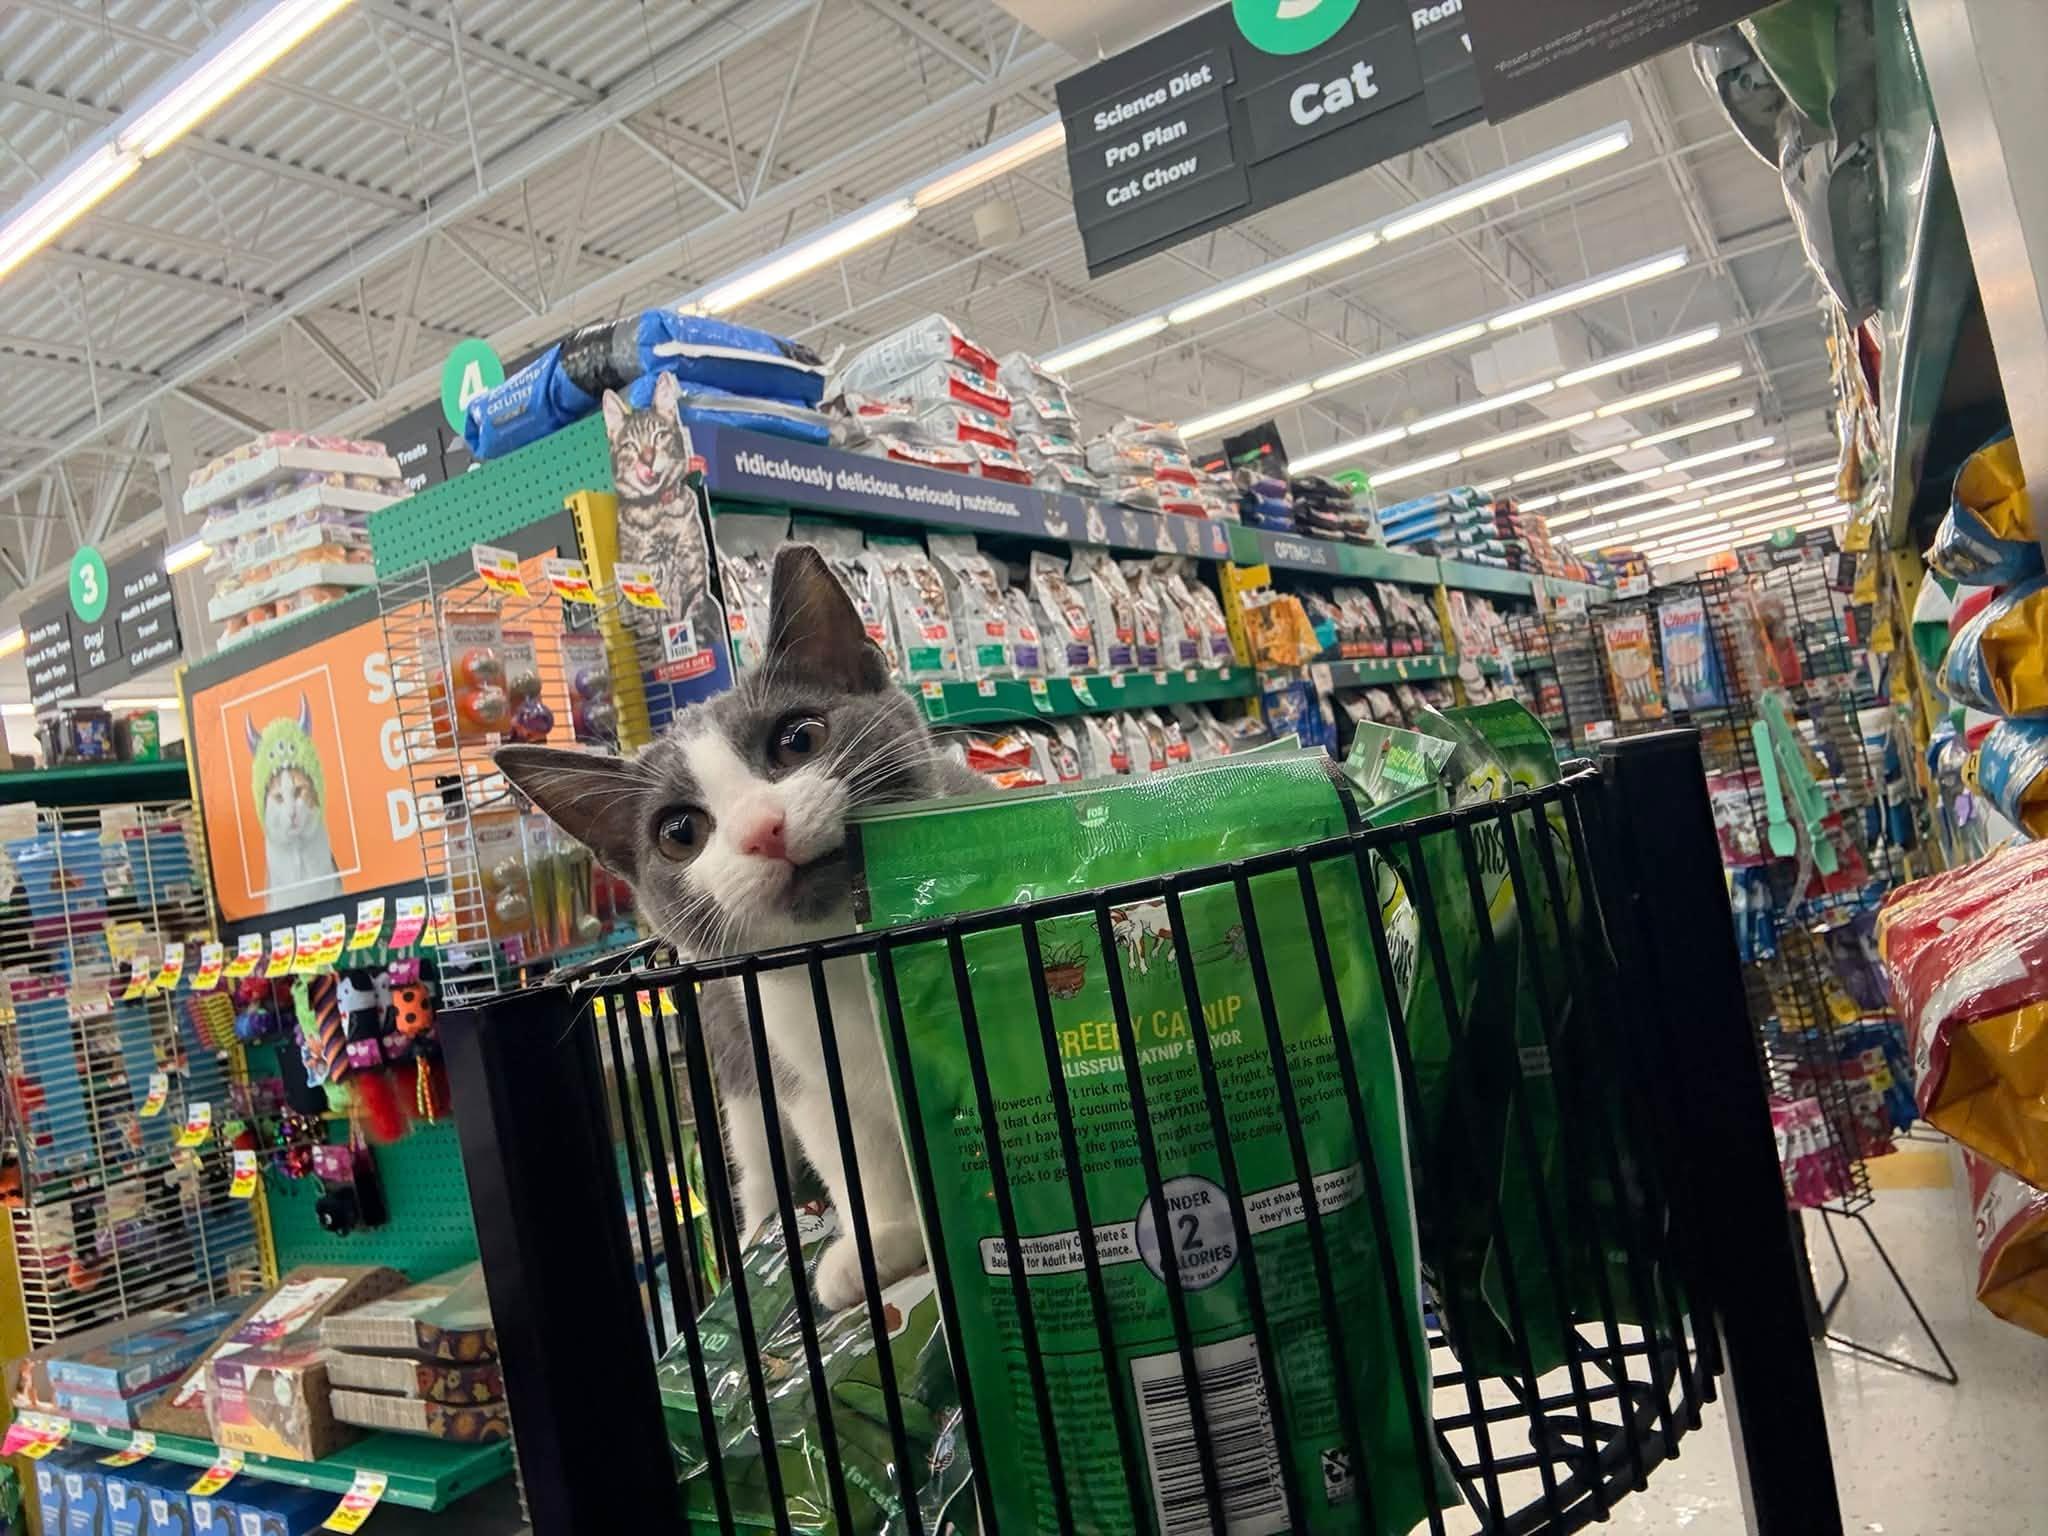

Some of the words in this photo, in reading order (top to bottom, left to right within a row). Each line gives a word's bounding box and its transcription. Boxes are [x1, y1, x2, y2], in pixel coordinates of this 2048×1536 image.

[1093, 88, 1167, 131] Science
[1168, 64, 1213, 98] Diet
[1289, 60, 1379, 126] Cat
[1105, 142, 1140, 168] Pro
[1142, 120, 1188, 151] Plan
[1105, 179, 1141, 207] Cat
[1142, 156, 1198, 191] Chow
[459, 359, 490, 412] 4
[397, 443, 428, 466] Treats
[735, 451, 833, 491] ridiculously
[836, 470, 905, 500] delicious.
[904, 484, 961, 511] seriously
[79, 563, 98, 605] 3
[89, 650, 106, 667] Cat
[1055, 1016, 1143, 1058] REEY
[1152, 996, 1242, 1038] CANIP
[1061, 1055, 1125, 1079] LISSFU
[1137, 1041, 1184, 1066] ATNIP
[1186, 1030, 1243, 1055] FVOR
[993, 1096, 1042, 1113] lloween
[1081, 1082, 1109, 1097] trick
[1147, 1070, 1173, 1087] treat
[1213, 1060, 1233, 1072] ose
[1236, 1049, 1268, 1068] pesky
[1004, 1115, 1029, 1130] that
[1080, 1099, 1131, 1116] cucumb
[1175, 1085, 1199, 1103] gave
[1035, 1130, 1057, 1144] hav
[1093, 1119, 1137, 1136] yummy
[1235, 1086, 1275, 1104] Creepy
[1015, 1154, 1039, 1168] you
[1044, 1148, 1065, 1161] sha
[1086, 1140, 1105, 1154] the
[1158, 1123, 1192, 1142] might
[1229, 1105, 1274, 1122] running
[1010, 1170, 1037, 1185] rick
[1038, 1169, 1051, 1180] to
[1055, 1167, 1070, 1182] ge
[1083, 1160, 1111, 1173] ome
[1114, 1158, 1139, 1169] mor
[1166, 1191, 1210, 1211] NDER
[1249, 1198, 1271, 1213] Just
[1259, 1206, 1292, 1225] they'll
[1018, 1237, 1072, 1255] utritionally
[1073, 1230, 1119, 1248] Cplete
[1120, 1227, 1129, 1239] &
[1178, 1214, 1202, 1251] 2
[1026, 1256, 1040, 1268] for
[1042, 1253, 1067, 1266] Adult
[1069, 1247, 1133, 1264] Maenance.
[1160, 1244, 1232, 1270] LORIES
